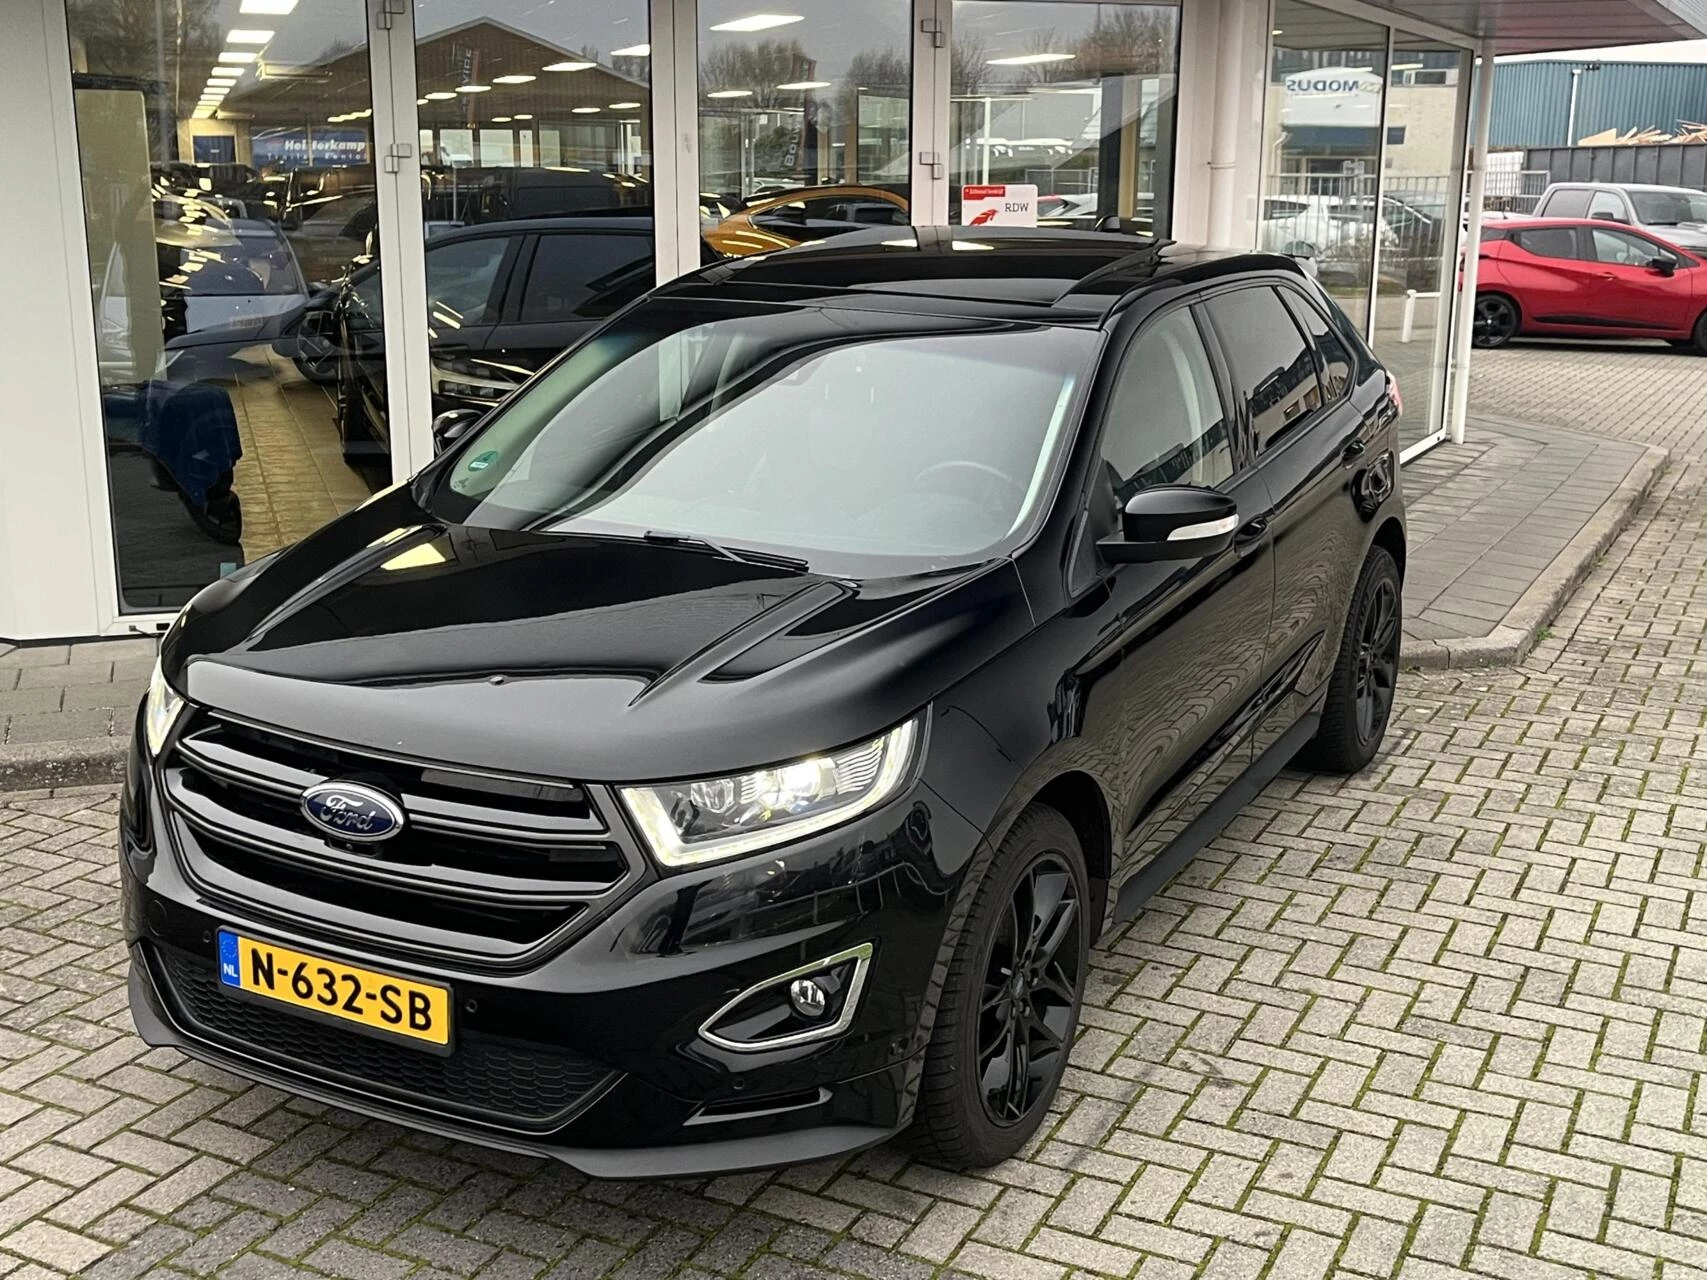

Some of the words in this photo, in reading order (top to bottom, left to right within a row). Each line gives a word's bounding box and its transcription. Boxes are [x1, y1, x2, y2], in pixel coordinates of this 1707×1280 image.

[284, 139, 364, 152] Heiterkamp
[1004, 202, 1029, 212] RDW
[320, 794, 377, 830] Ford
[223, 963, 238, 978] NL
[251, 947, 432, 1032] N-632-SB
